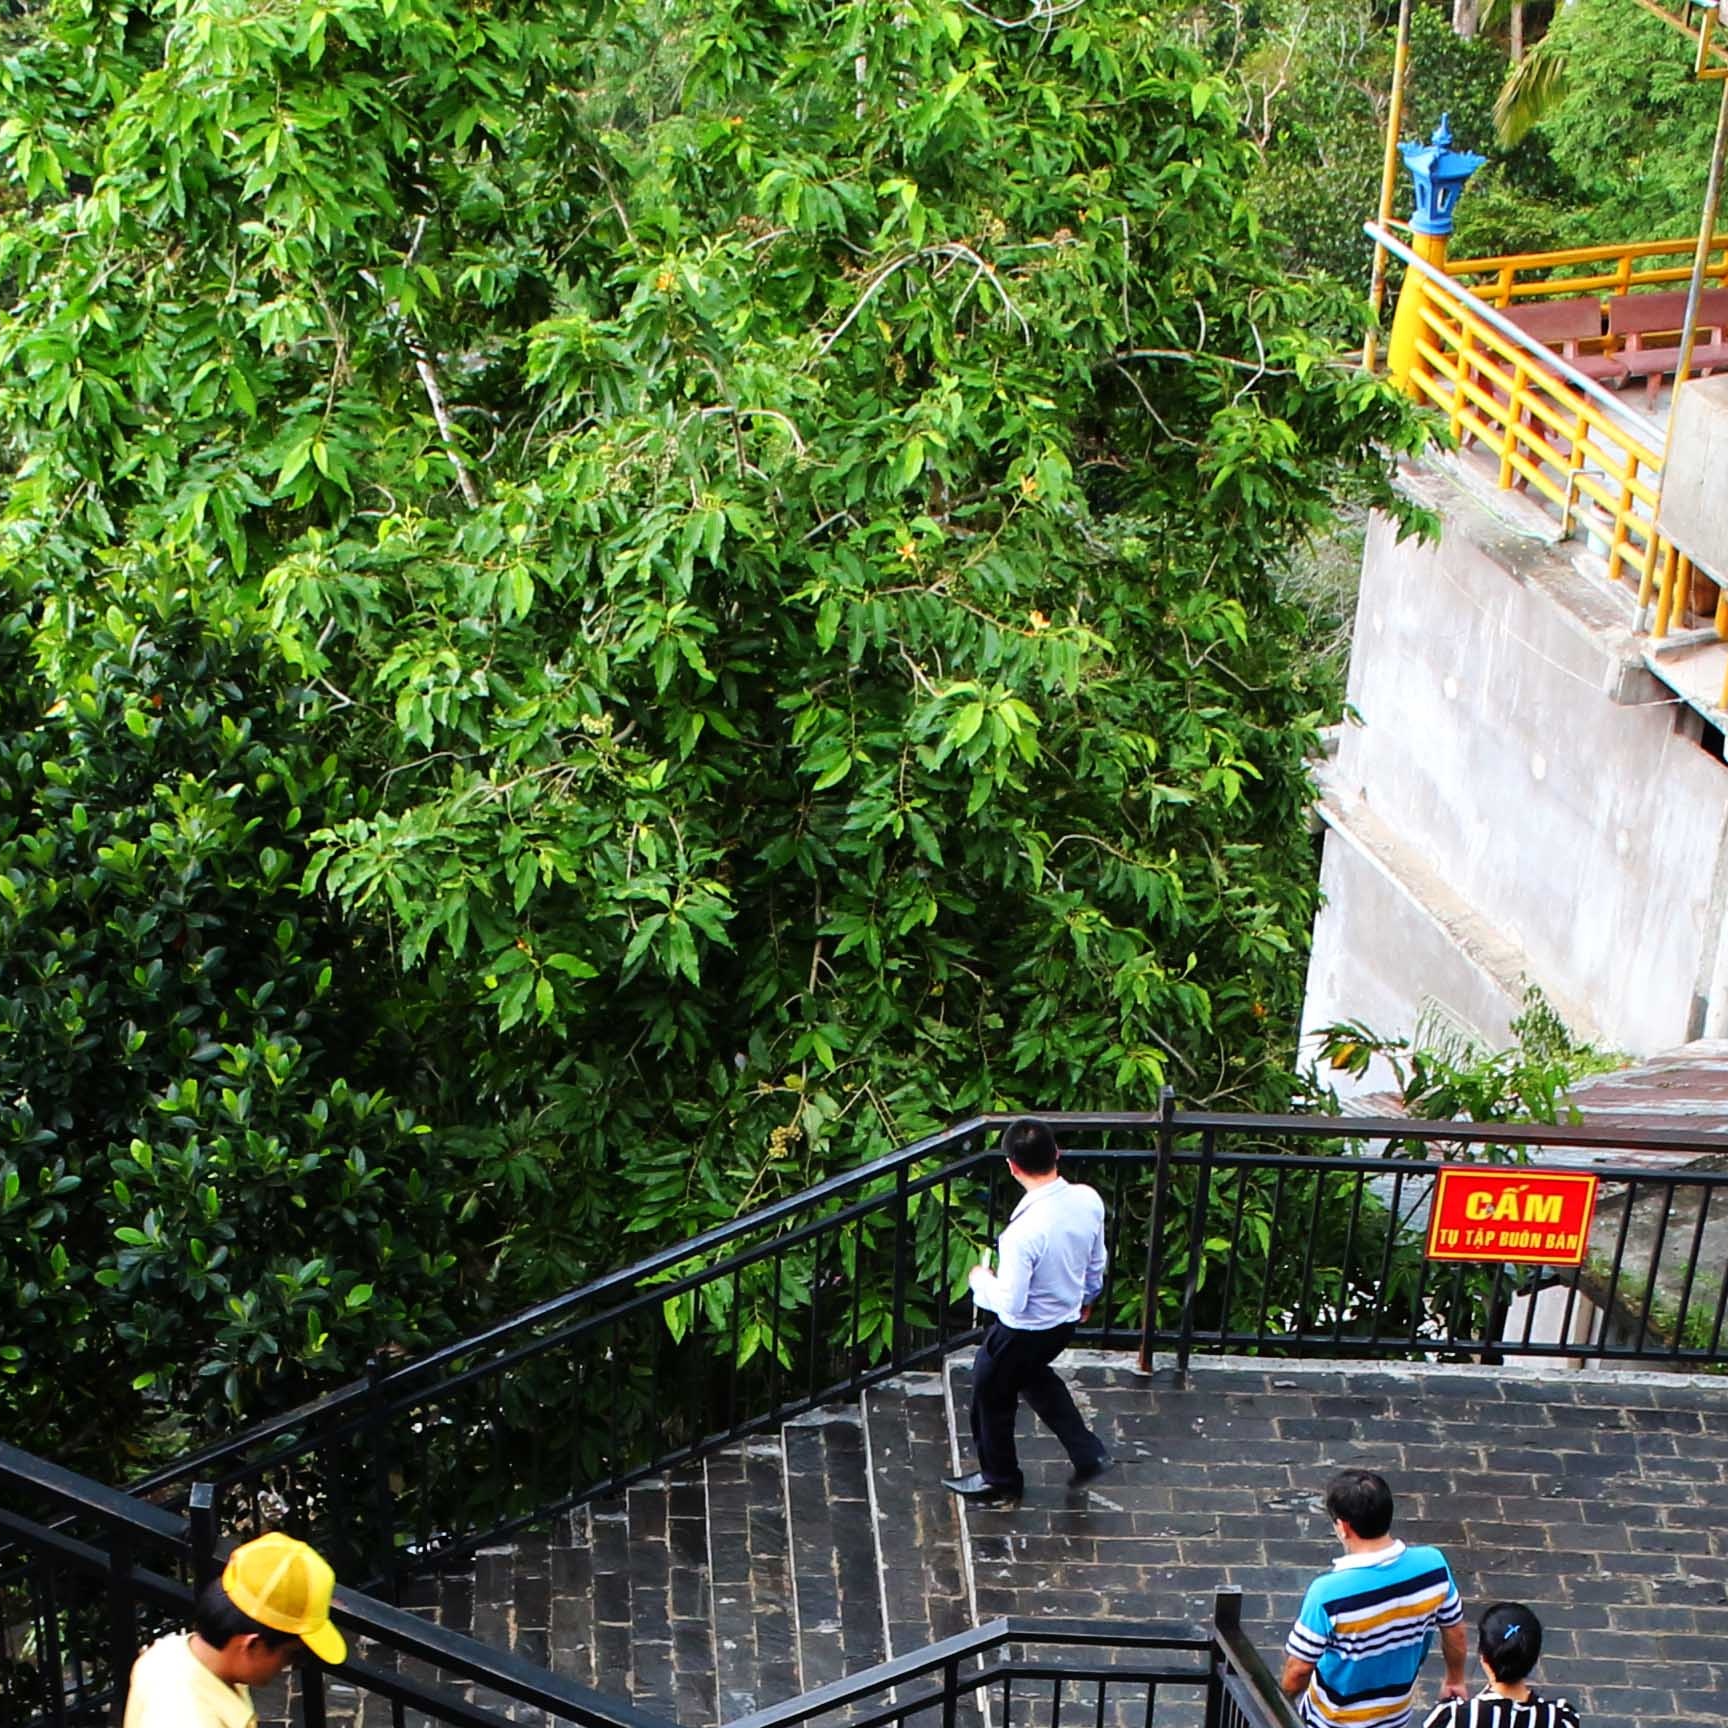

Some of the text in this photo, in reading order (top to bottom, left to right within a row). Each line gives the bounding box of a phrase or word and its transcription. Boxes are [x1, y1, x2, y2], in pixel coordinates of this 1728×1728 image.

[1465, 1184, 1564, 1223] CẤM
[1440, 1228, 1578, 1250] TỤ TẬP BUÔN BÁN
